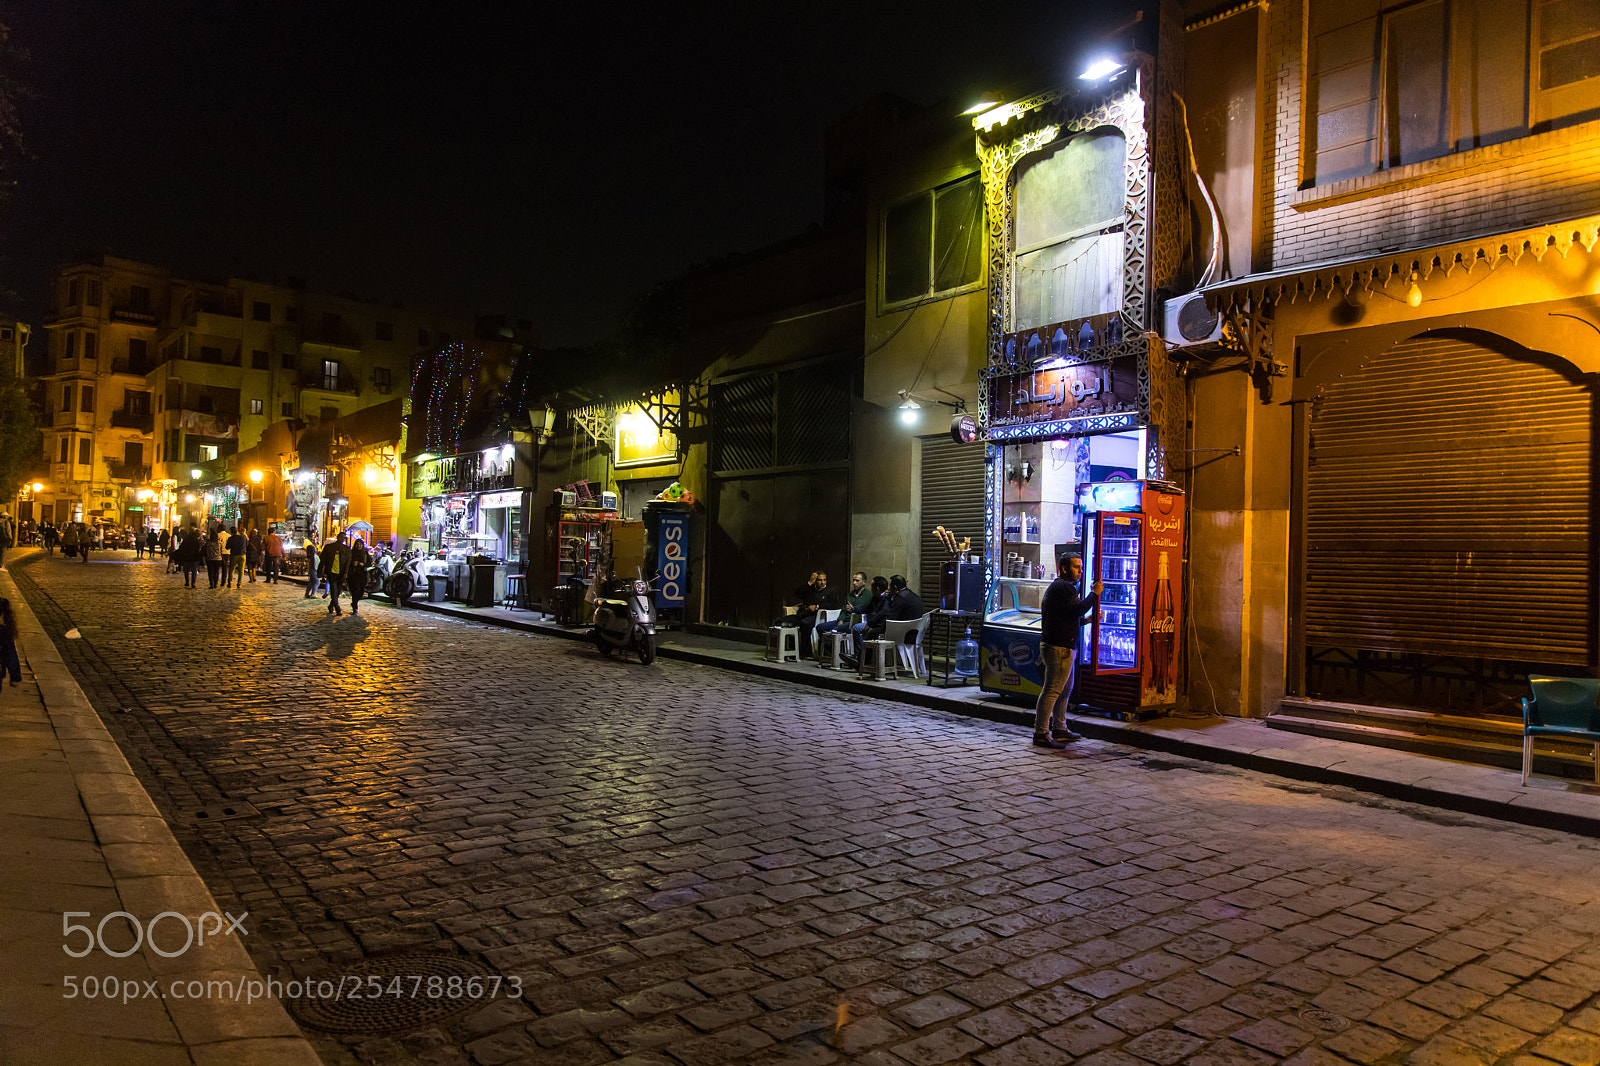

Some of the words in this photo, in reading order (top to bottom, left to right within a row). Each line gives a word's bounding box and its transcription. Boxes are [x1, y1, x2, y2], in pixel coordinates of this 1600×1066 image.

[1016, 374, 1065, 405] زياد
[1071, 368, 1110, 401] ابو
[661, 519, 686, 601] pepsi
